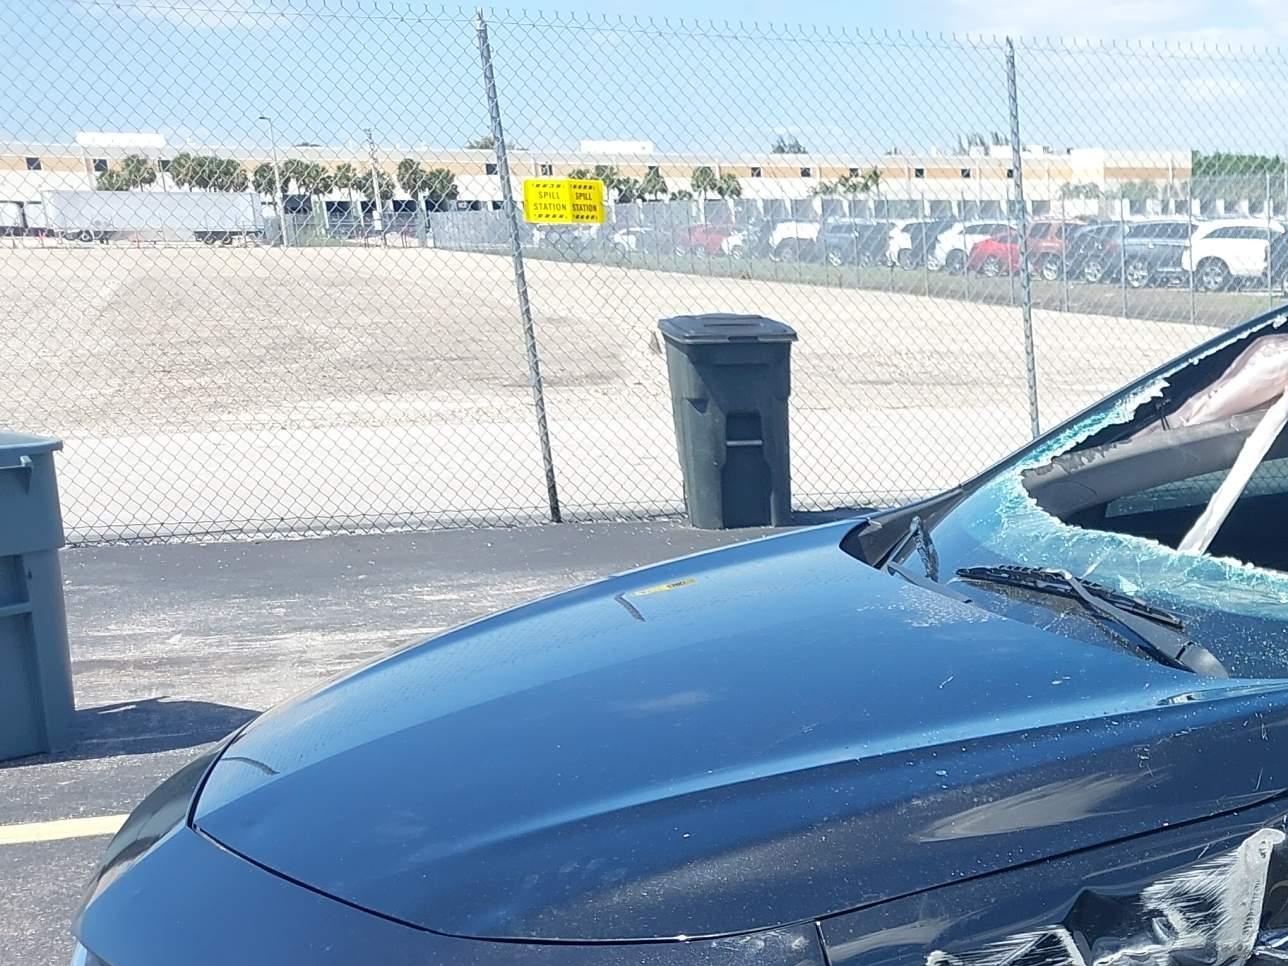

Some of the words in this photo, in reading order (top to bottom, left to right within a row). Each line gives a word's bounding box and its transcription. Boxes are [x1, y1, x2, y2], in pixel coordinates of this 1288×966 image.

[538, 191, 560, 200] SPILL
[575, 191, 592, 201] SPILL
[533, 202, 567, 211] STATION
[572, 203, 597, 212] STATION
